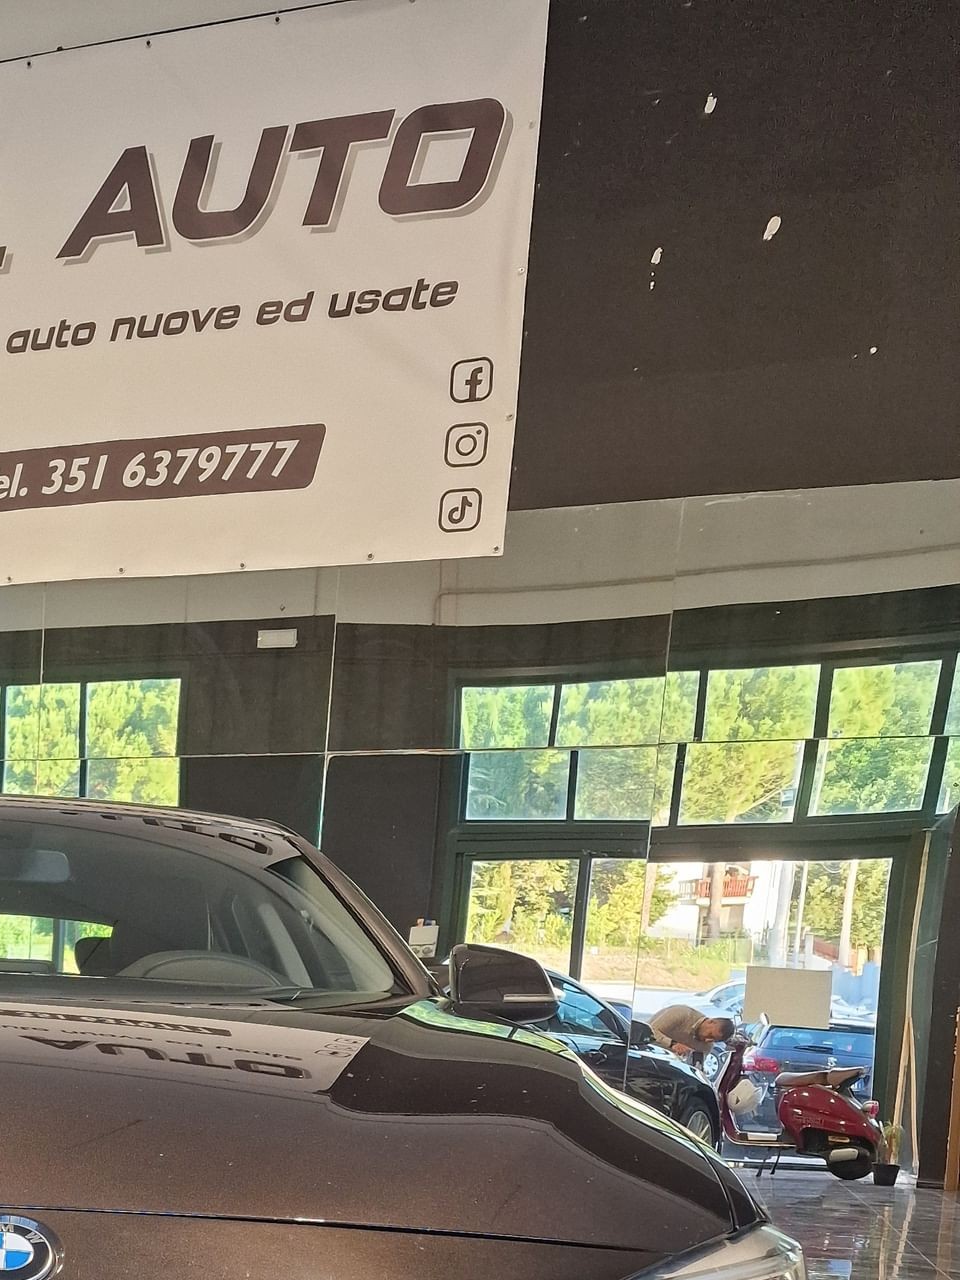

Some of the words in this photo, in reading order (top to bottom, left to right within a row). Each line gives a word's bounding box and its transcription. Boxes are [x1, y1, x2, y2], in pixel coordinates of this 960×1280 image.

[55, 97, 512, 260] AUTO
[6, 319, 97, 355] auto
[109, 304, 241, 342] nuove
[256, 291, 315, 325] ed
[327, 278, 459, 318] usate
[41, 455, 109, 495] 351
[121, 439, 300, 488] 6379777
